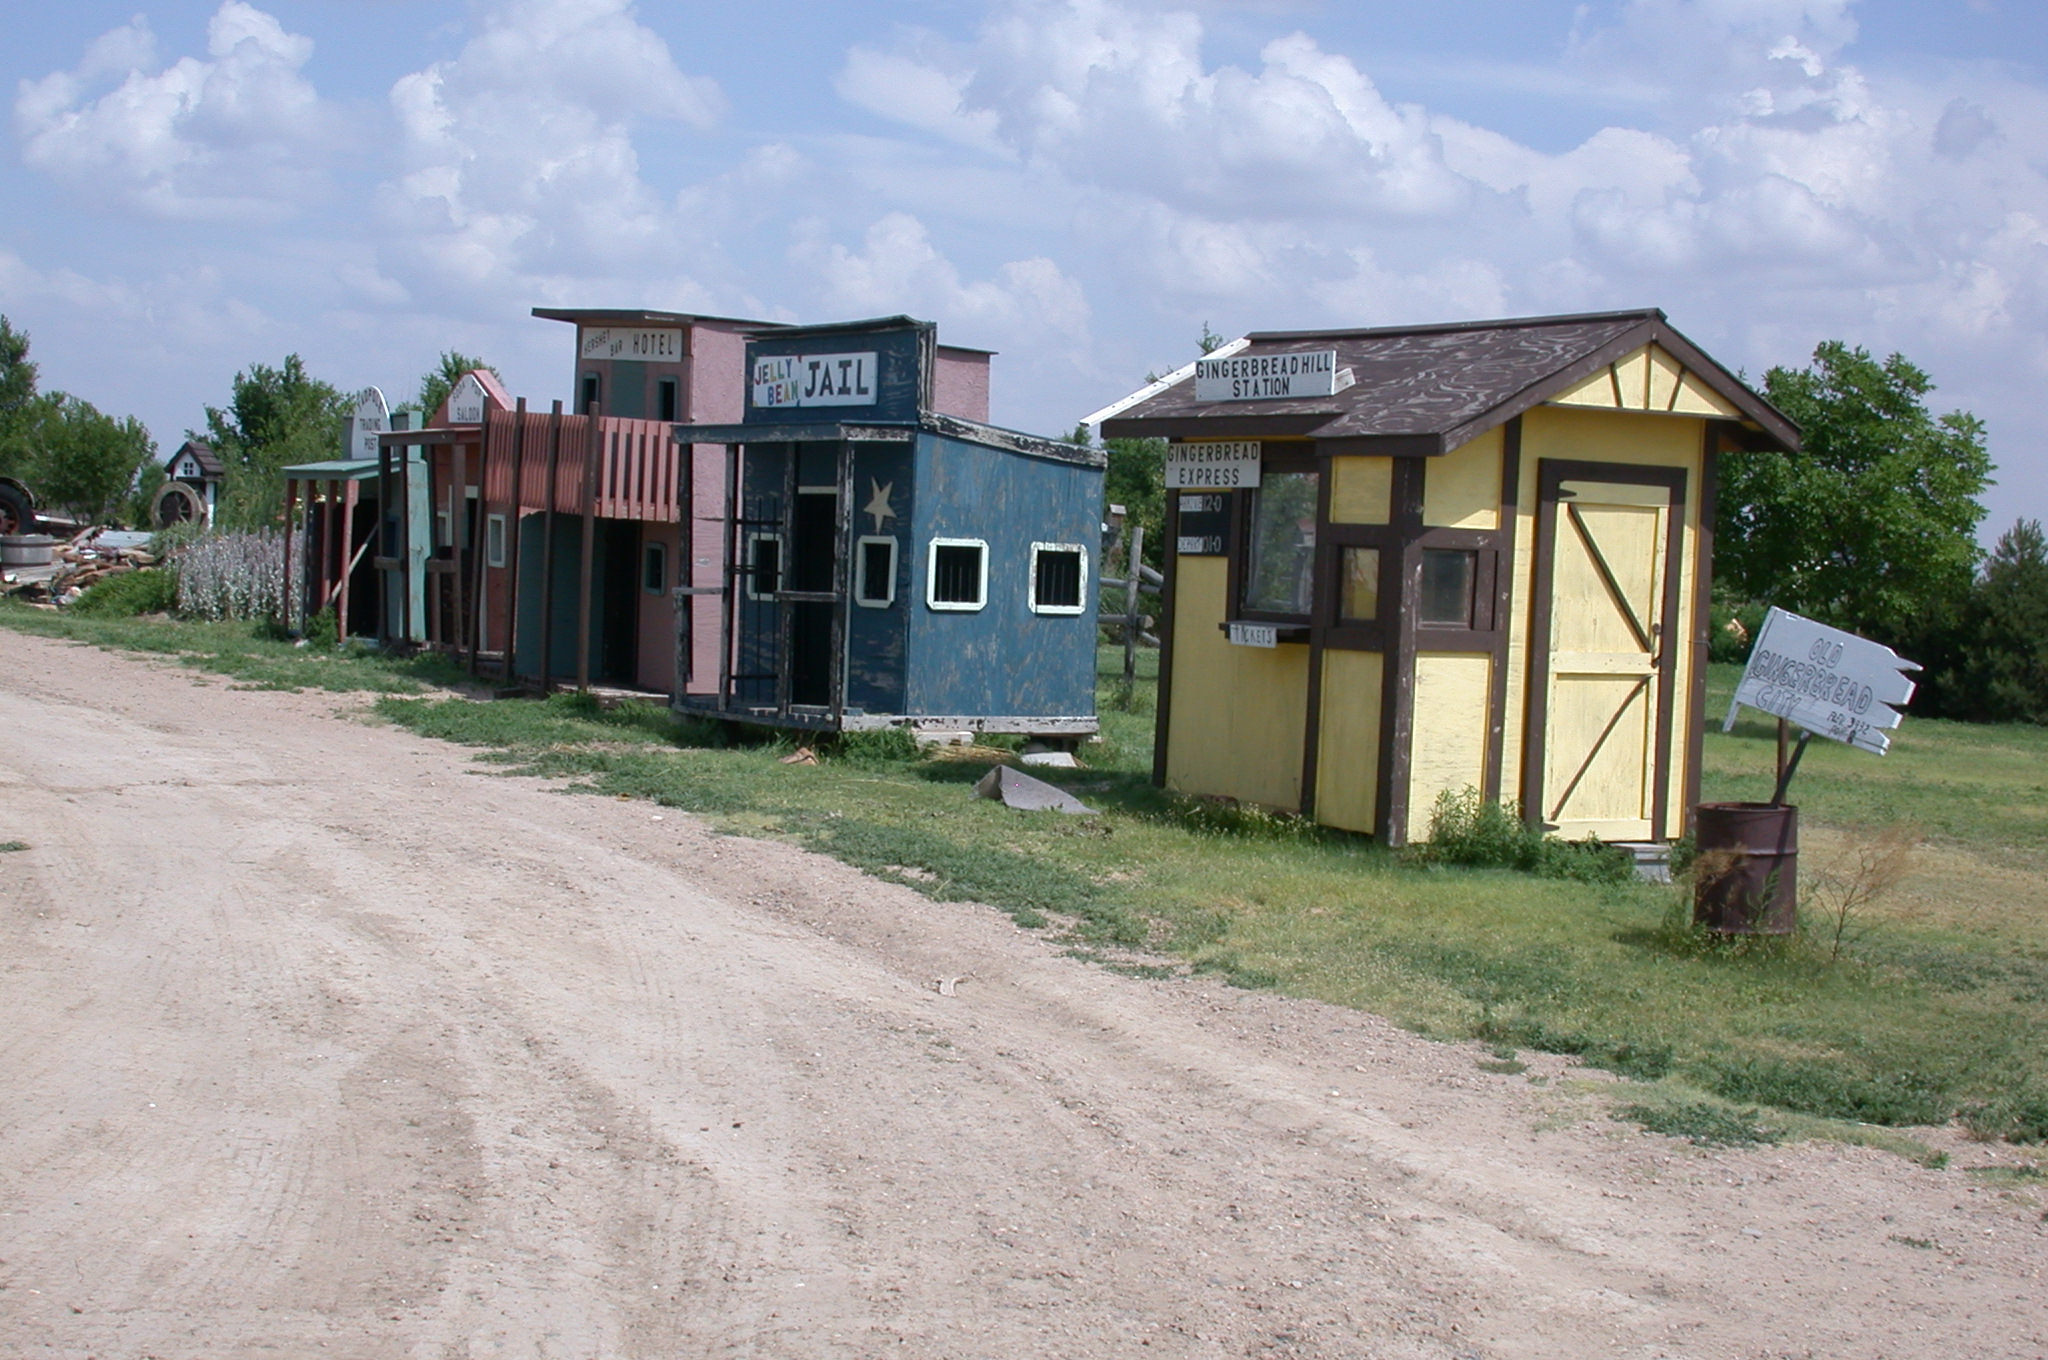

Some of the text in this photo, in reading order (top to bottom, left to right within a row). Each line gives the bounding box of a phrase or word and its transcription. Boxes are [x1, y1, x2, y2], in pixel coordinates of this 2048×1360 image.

[610, 340, 622, 357] BAR
[633, 333, 673, 355] HOTEL
[755, 358, 792, 385] JELLY
[1196, 353, 1331, 379] GINGERBREAD HILL
[805, 359, 869, 398] JAIL
[1233, 376, 1290, 398] STATION
[768, 380, 798, 405] BEAN
[359, 418, 381, 431] TRADING
[457, 407, 480, 421] SALOON
[364, 437, 378, 451] POST
[1167, 443, 1259, 462] GINGERBREAD
[1179, 467, 1240, 486] EXPRESS
[1231, 624, 1273, 644] TICKETS
[1808, 638, 1844, 669] OLD
[1753, 650, 1873, 715] GINGERBREAD
[1756, 685, 1802, 719] CITY
